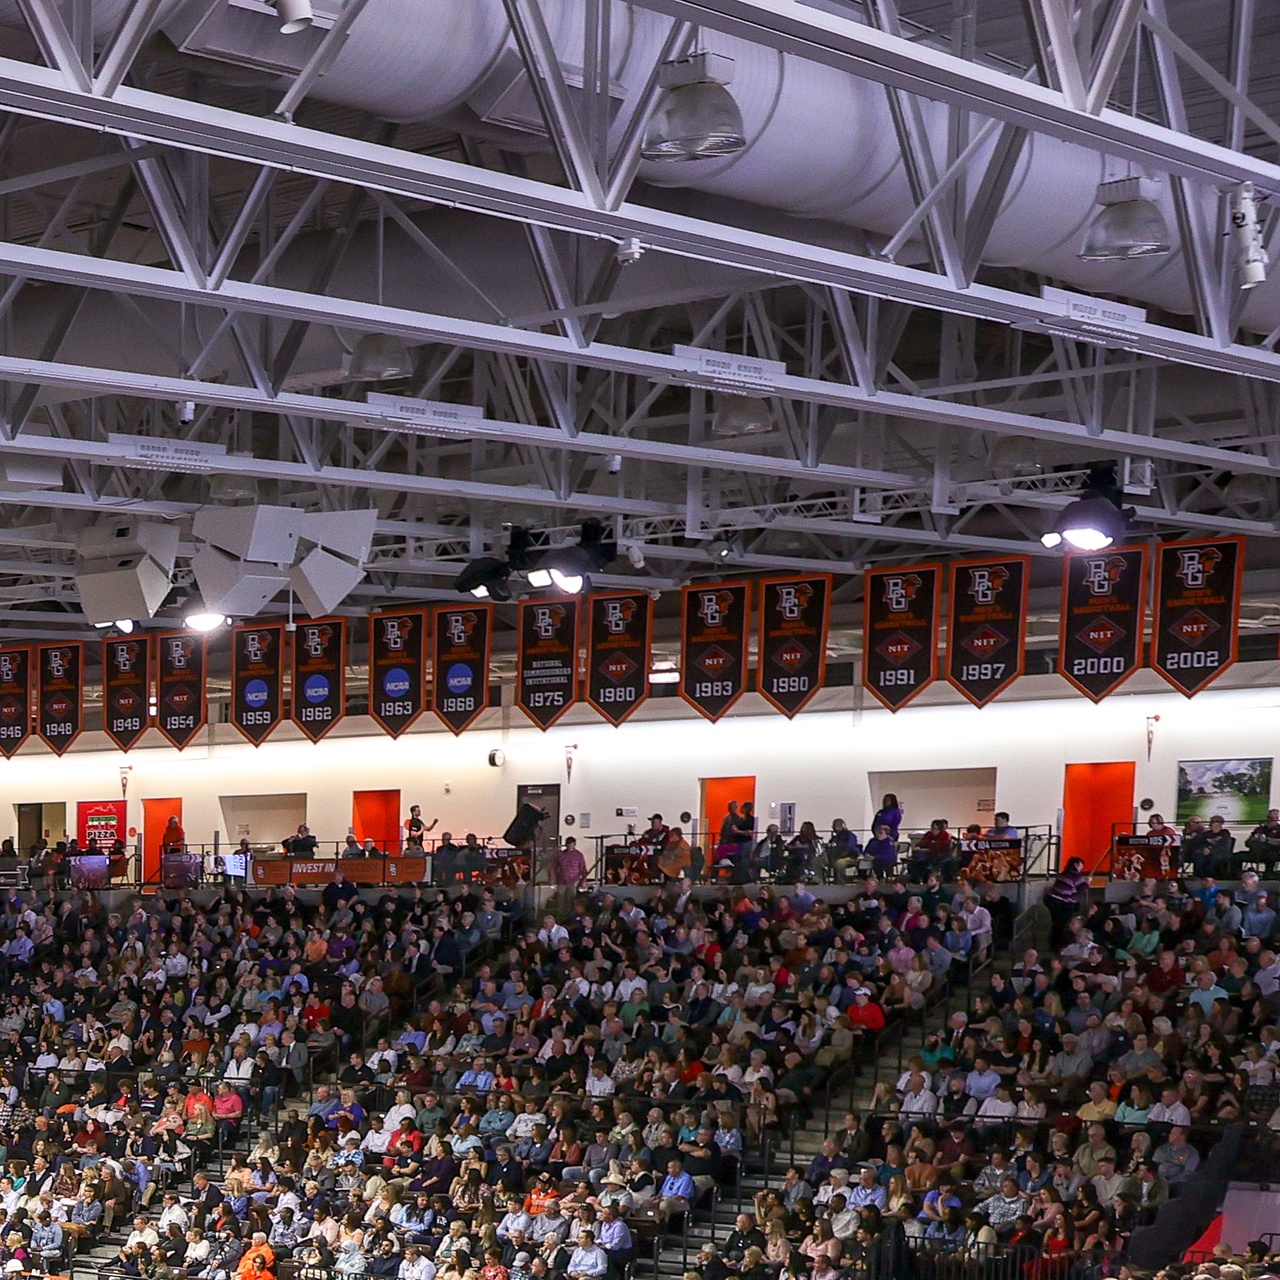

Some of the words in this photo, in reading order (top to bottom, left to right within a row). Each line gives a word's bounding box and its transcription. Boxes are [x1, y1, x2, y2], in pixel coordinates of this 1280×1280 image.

[1090, 630, 1114, 639] NIT
[1182, 624, 1208, 632] NIT
[973, 638, 997, 646] NIT
[705, 658, 725, 666] NIT
[782, 653, 800, 661] NIT
[1166, 651, 1219, 669] 2002
[961, 663, 1005, 681] 1997
[1073, 657, 1124, 675] 2000
[772, 676, 809, 693] 1990
[879, 669, 915, 686] 1991
[600, 687, 635, 702] 1980
[695, 681, 732, 697] 1983
[443, 697, 475, 712] 1968
[529, 691, 564, 707] 1975
[302, 707, 332, 721] 1962
[381, 701, 412, 716] 1963
[113, 718, 140, 732] 1949
[166, 716, 194, 729] 1954
[242, 711, 271, 725] 1959
[46, 722, 72, 736] 1948
[87, 831, 116, 839] PIZZA
[292, 863, 323, 873] INVEST
[325, 862, 336, 872] IN
